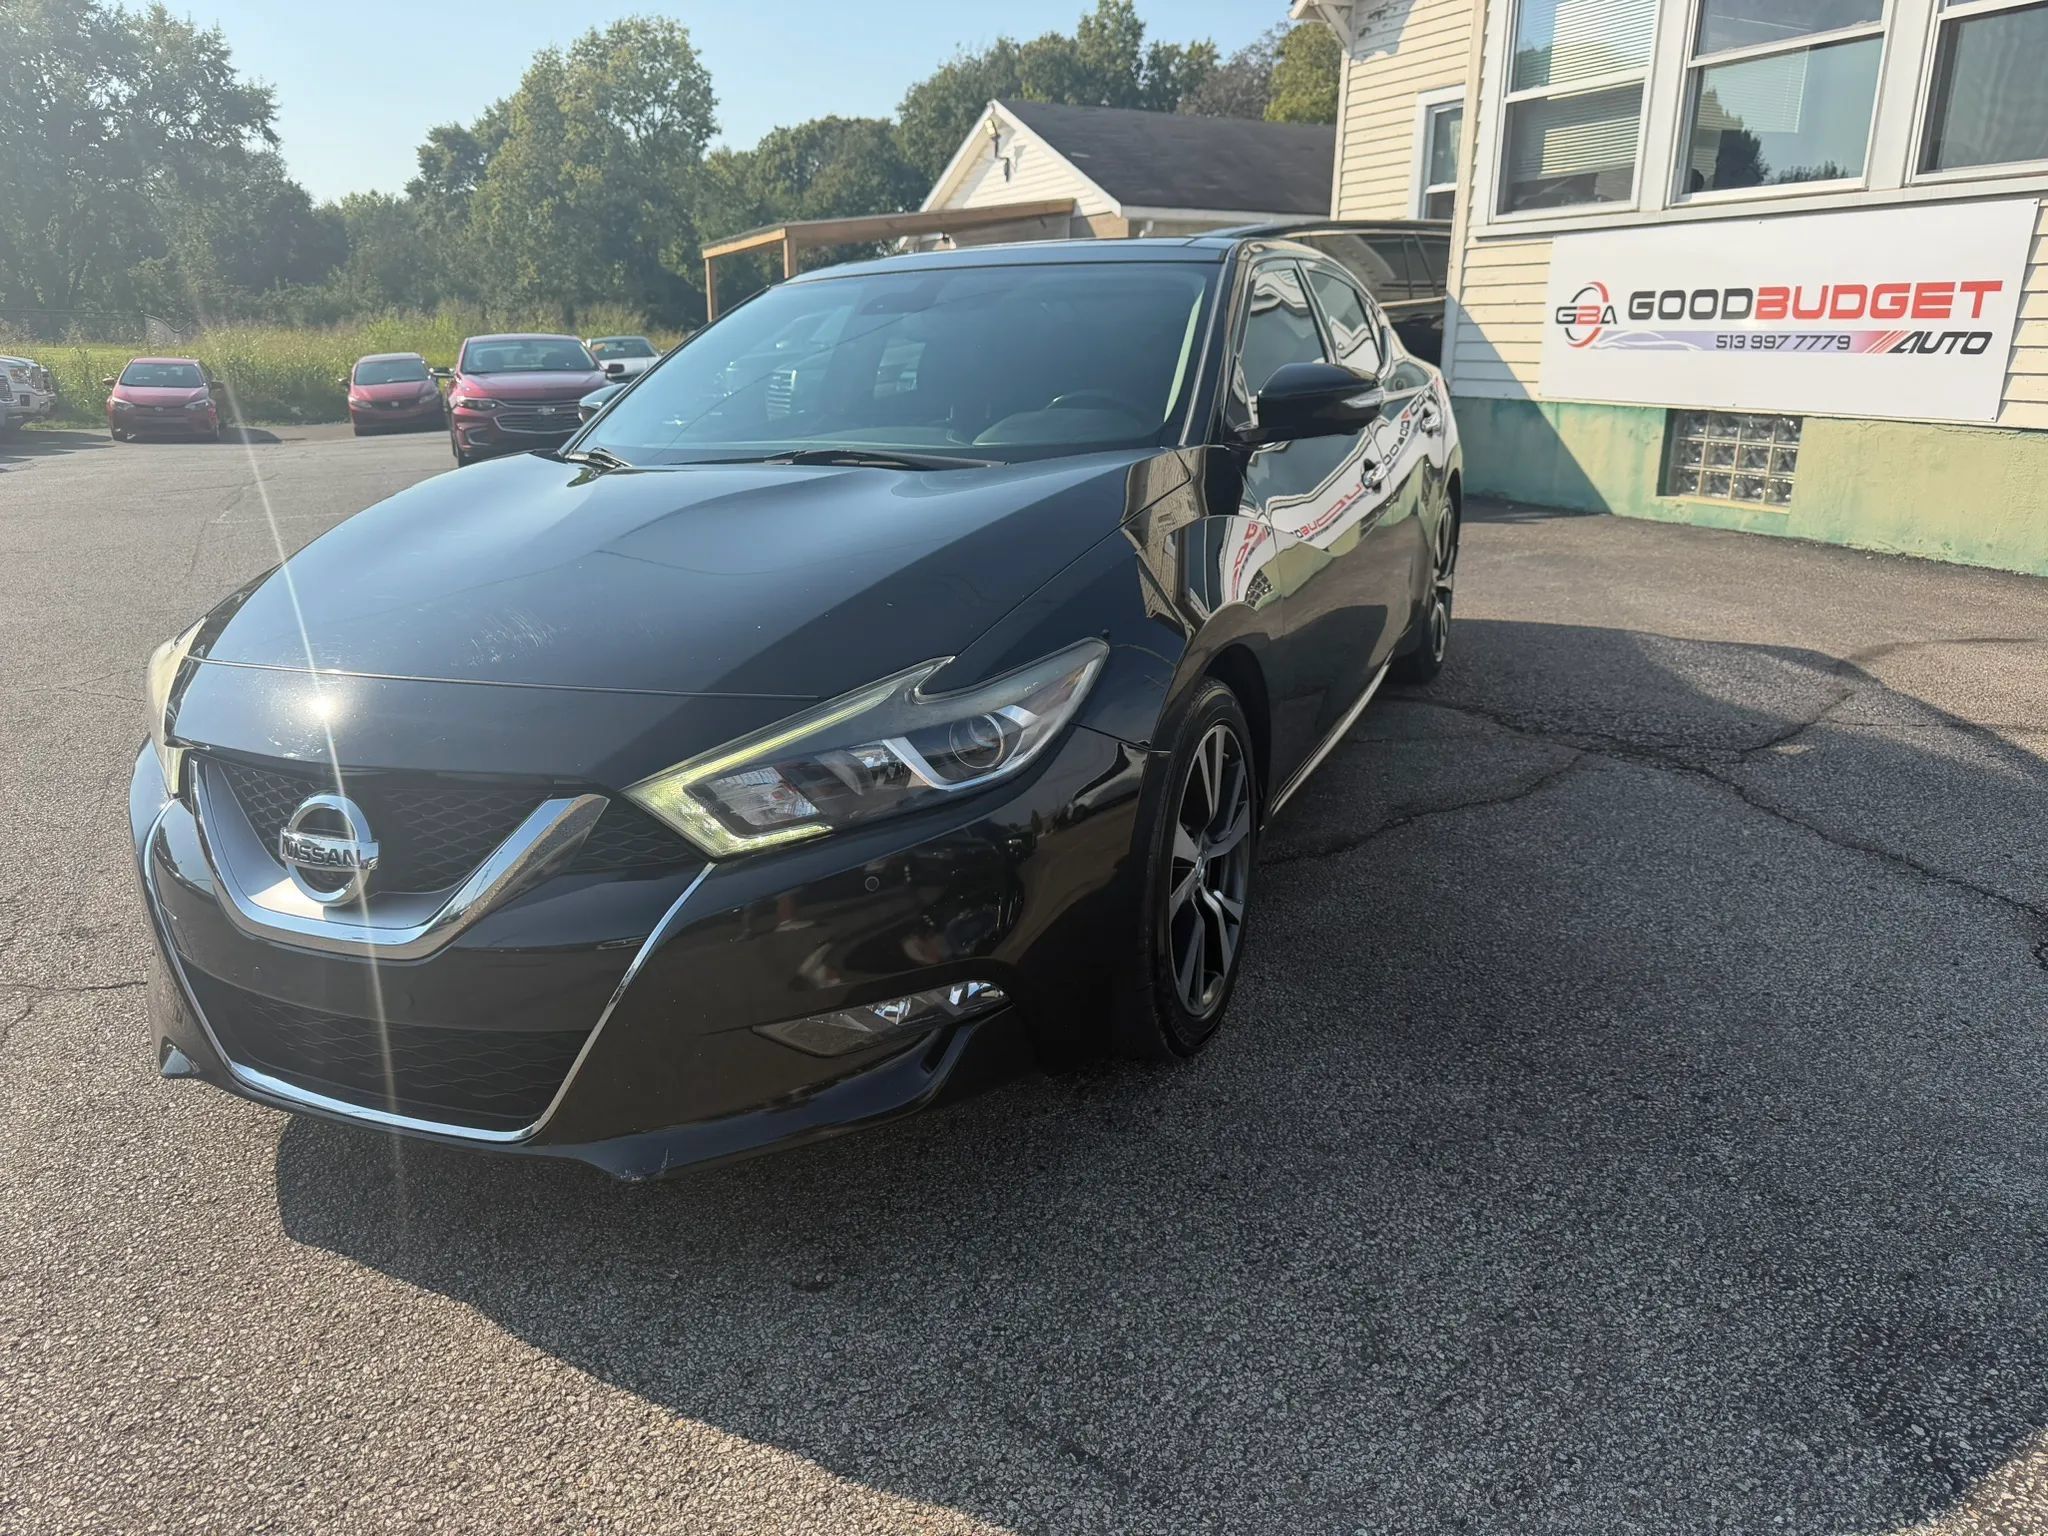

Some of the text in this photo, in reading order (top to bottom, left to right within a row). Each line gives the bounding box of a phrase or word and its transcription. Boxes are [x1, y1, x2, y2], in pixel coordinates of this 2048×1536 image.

[1628, 280, 2004, 321] GOODBUDGET
[1555, 304, 1618, 325] GBA
[1715, 334, 1851, 350] 513 997 7779
[1887, 330, 1993, 355] AUTO
[281, 834, 361, 868] NISSAN
